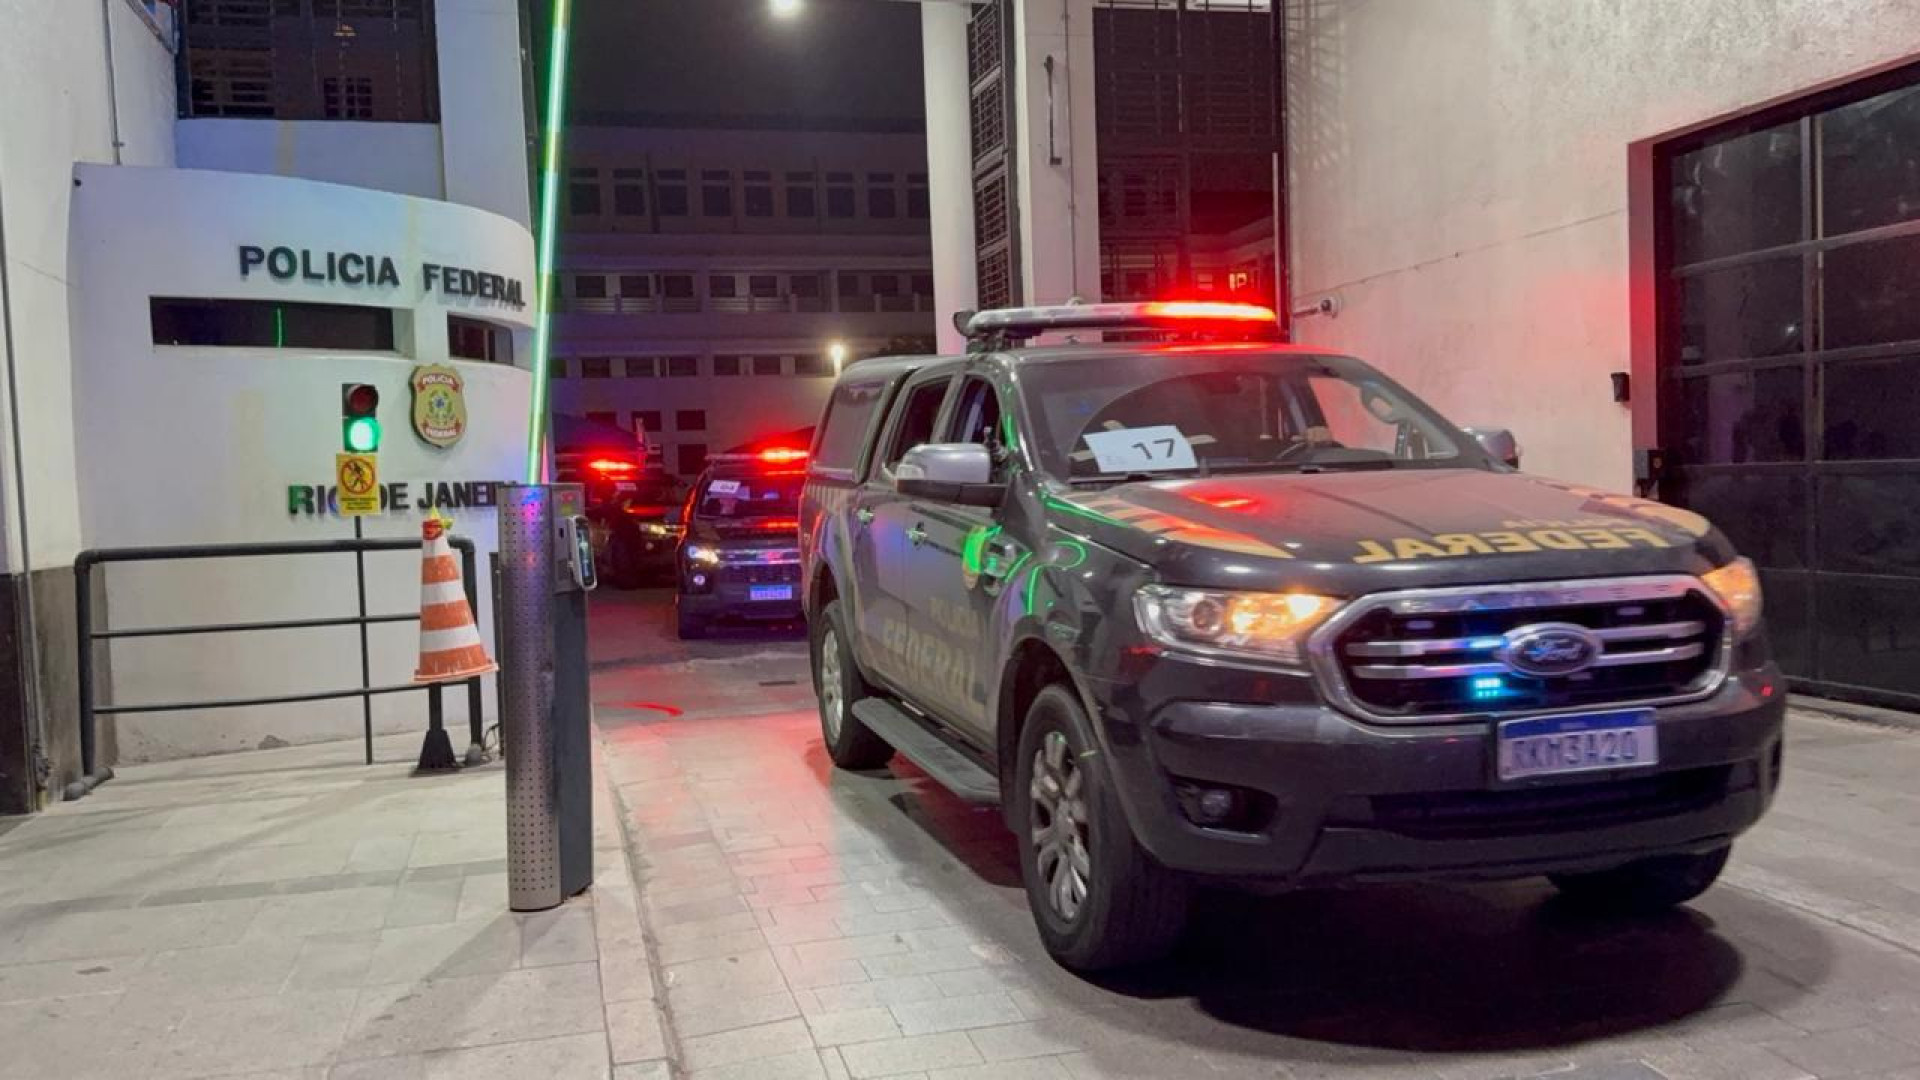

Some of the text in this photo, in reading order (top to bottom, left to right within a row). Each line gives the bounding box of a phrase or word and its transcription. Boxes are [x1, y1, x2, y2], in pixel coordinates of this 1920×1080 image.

[239, 246, 526, 307] POLICIA FEDERAL
[1132, 438, 1174, 459] 17
